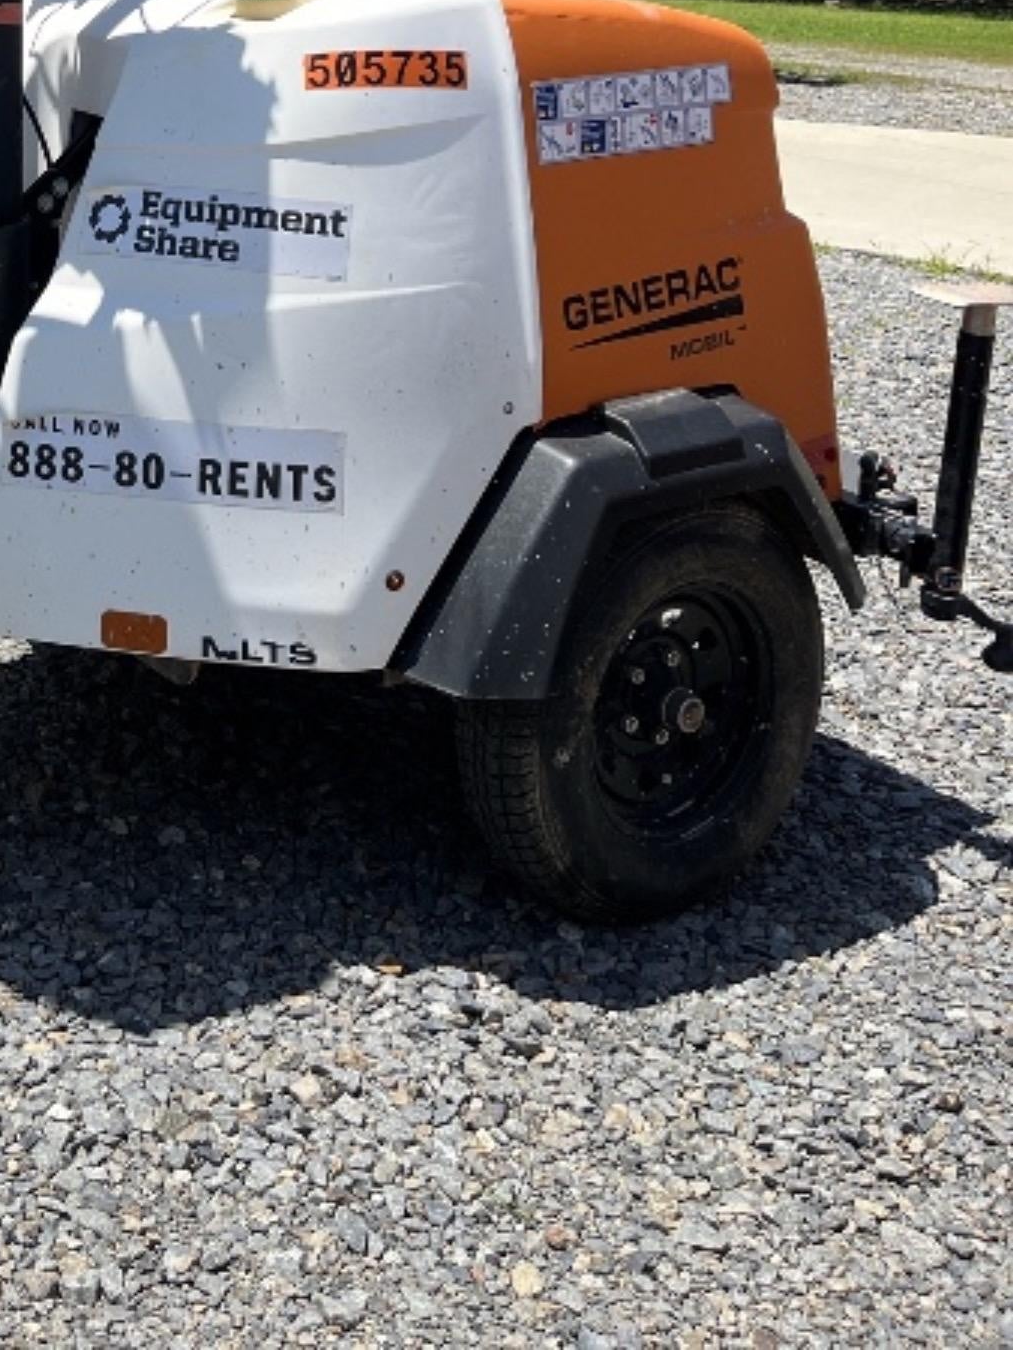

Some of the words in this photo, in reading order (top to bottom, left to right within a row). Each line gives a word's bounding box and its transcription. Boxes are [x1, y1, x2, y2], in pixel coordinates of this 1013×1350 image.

[307, 50, 466, 88] 505735
[139, 190, 348, 238] Equipment
[133, 224, 240, 262] Share
[562, 257, 741, 331] GENERAC
[670, 323, 746, 360] MOBIL
[73, 416, 121, 438] NOW
[7, 440, 337, 503] 888-80-RENTS
